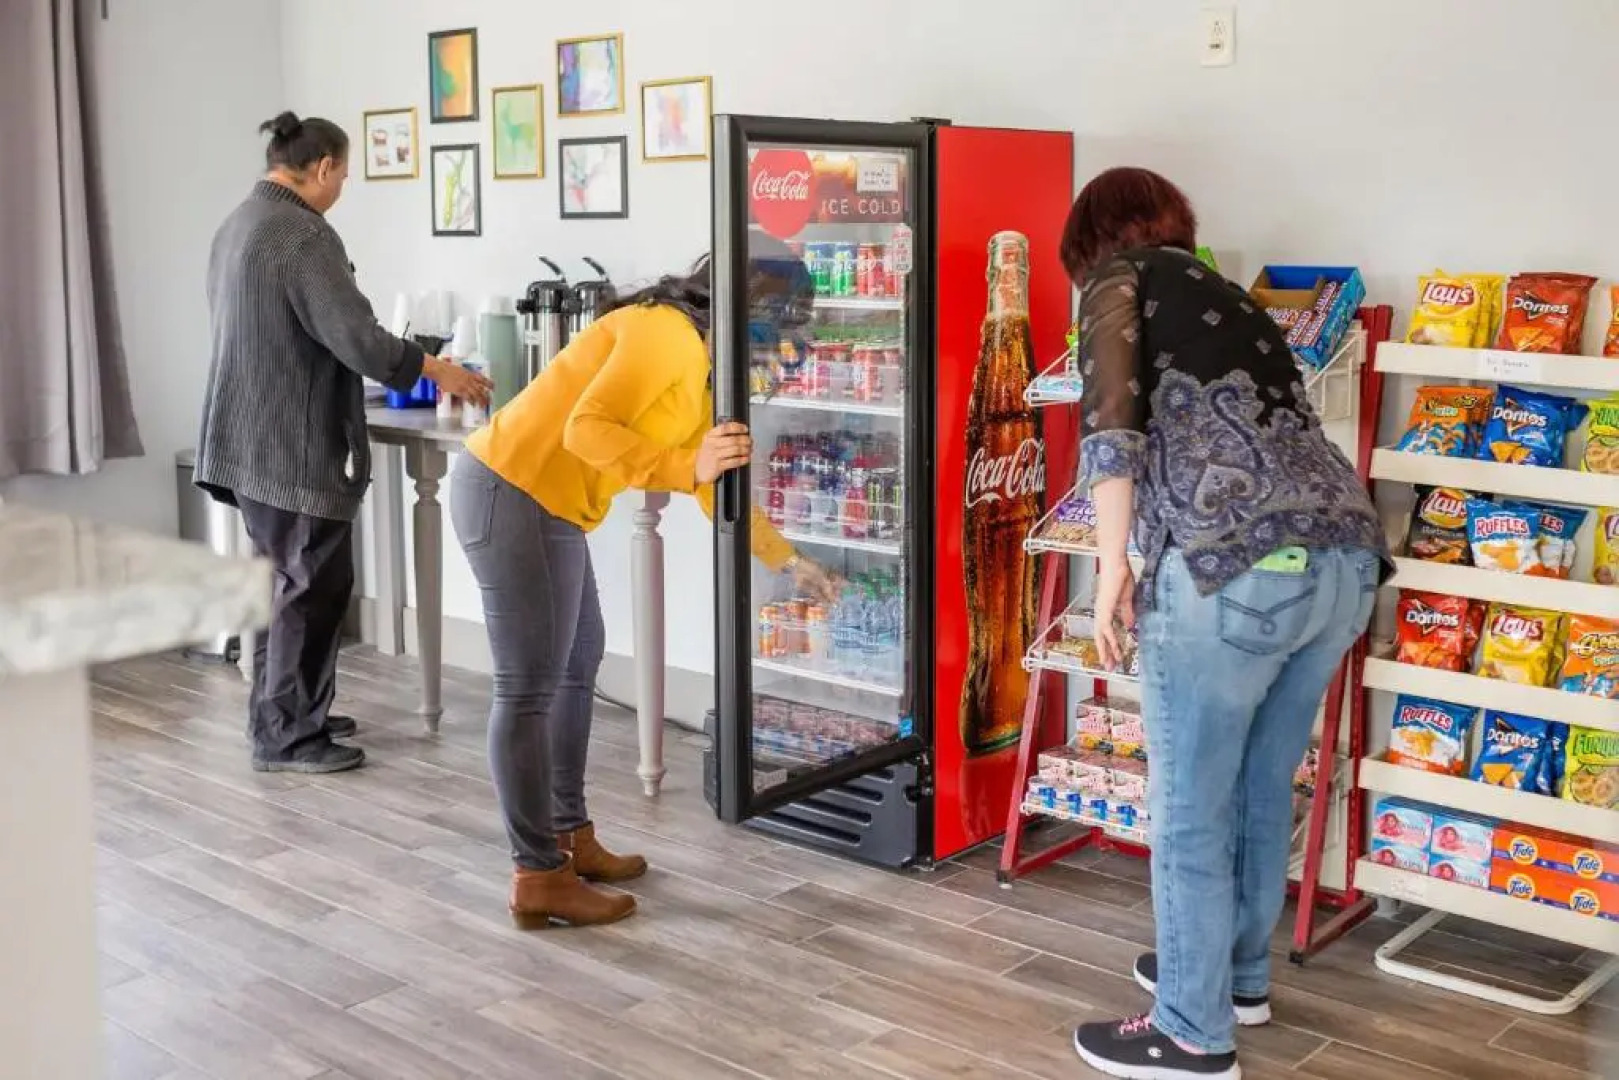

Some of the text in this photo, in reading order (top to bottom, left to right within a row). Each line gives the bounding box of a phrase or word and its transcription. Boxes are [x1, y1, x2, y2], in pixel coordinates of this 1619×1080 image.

[821, 199, 900, 215] ICE COLD
[1512, 296, 1569, 315] Doritos
[1493, 407, 1547, 427] Doritos
[1475, 517, 1530, 537] RUFFLES
[1406, 609, 1459, 626] Doritos
[1401, 706, 1453, 732] RUFFLES
[1488, 728, 1539, 748] Doritos
[1512, 843, 1535, 856] Tide
[1577, 856, 1600, 870] Tide
[1510, 880, 1533, 894] Tide
[1574, 895, 1597, 909] Tide
